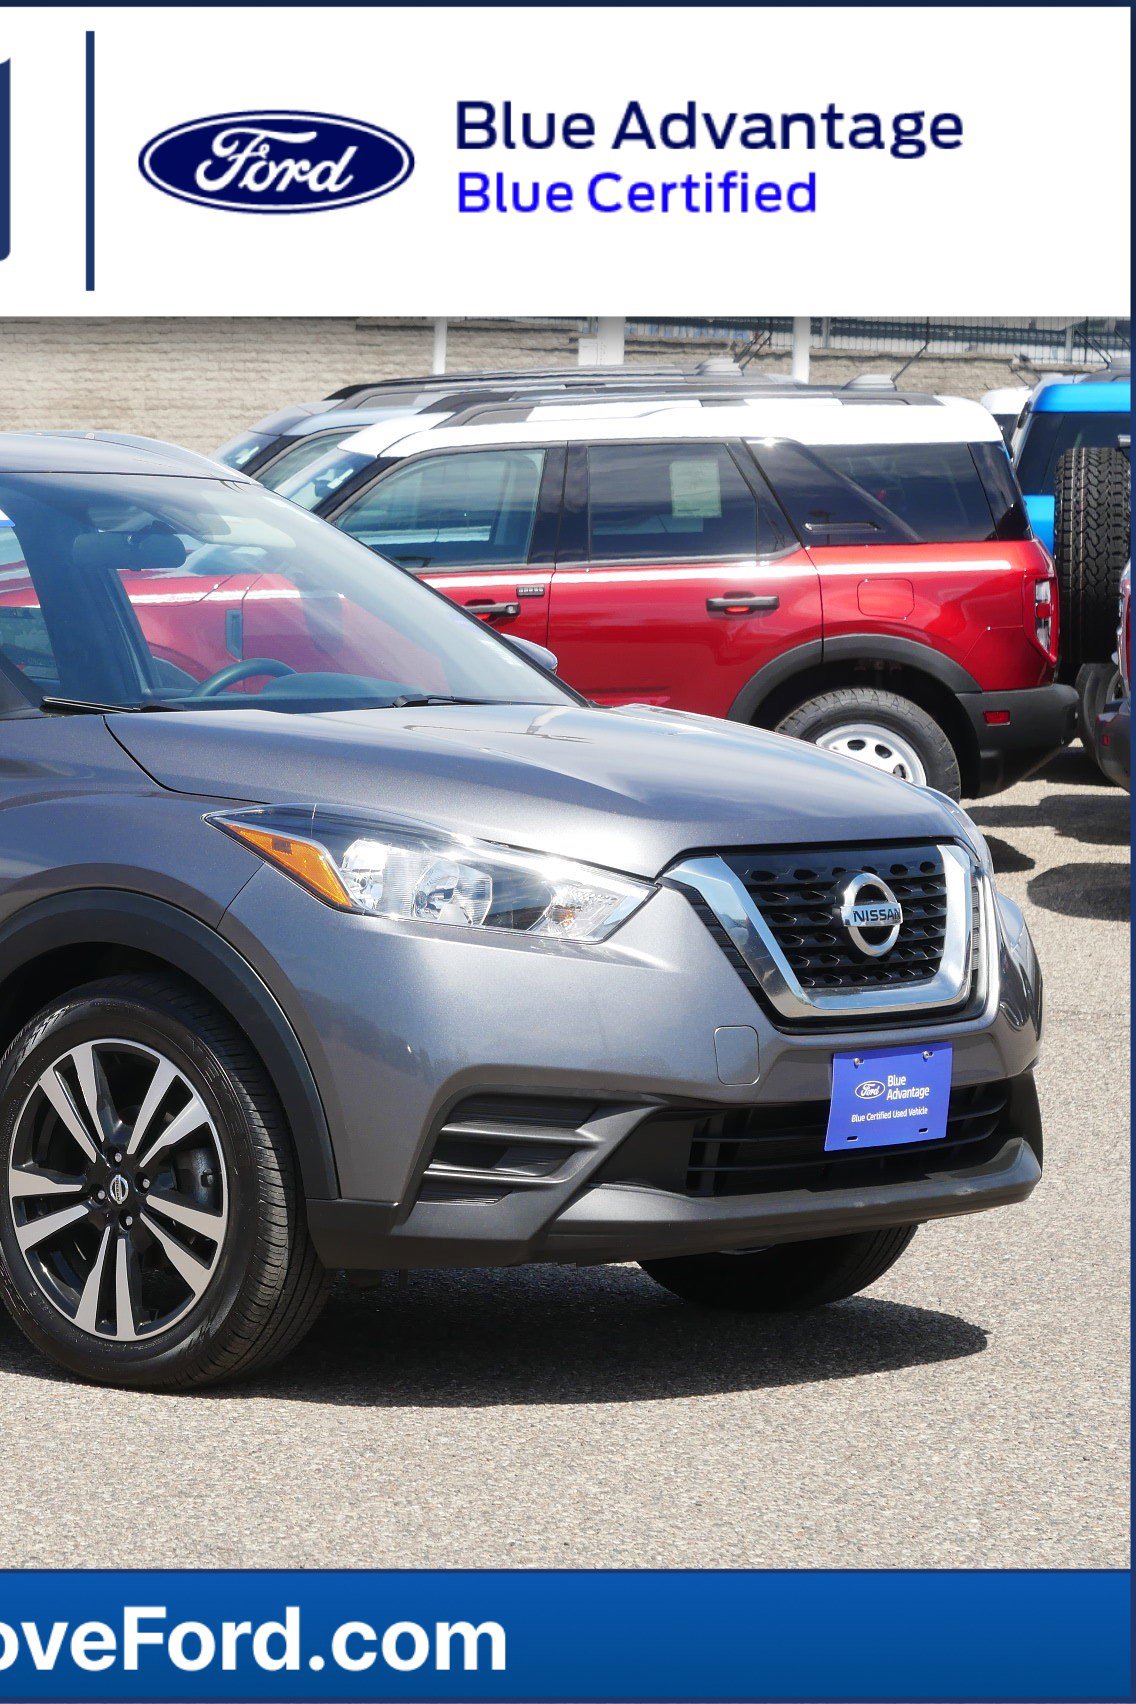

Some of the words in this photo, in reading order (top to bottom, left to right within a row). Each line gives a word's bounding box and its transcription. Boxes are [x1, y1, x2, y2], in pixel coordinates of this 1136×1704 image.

[852, 907, 901, 923] NISSAN
[887, 1074, 907, 1087] Blue
[860, 1083, 881, 1097] Ford
[886, 1085, 930, 1101] Advantage
[851, 1113, 866, 1123] Blue
[866, 1111, 892, 1122] Certified
[892, 1109, 908, 1119] Used
[908, 1106, 929, 1117] Vehicle
